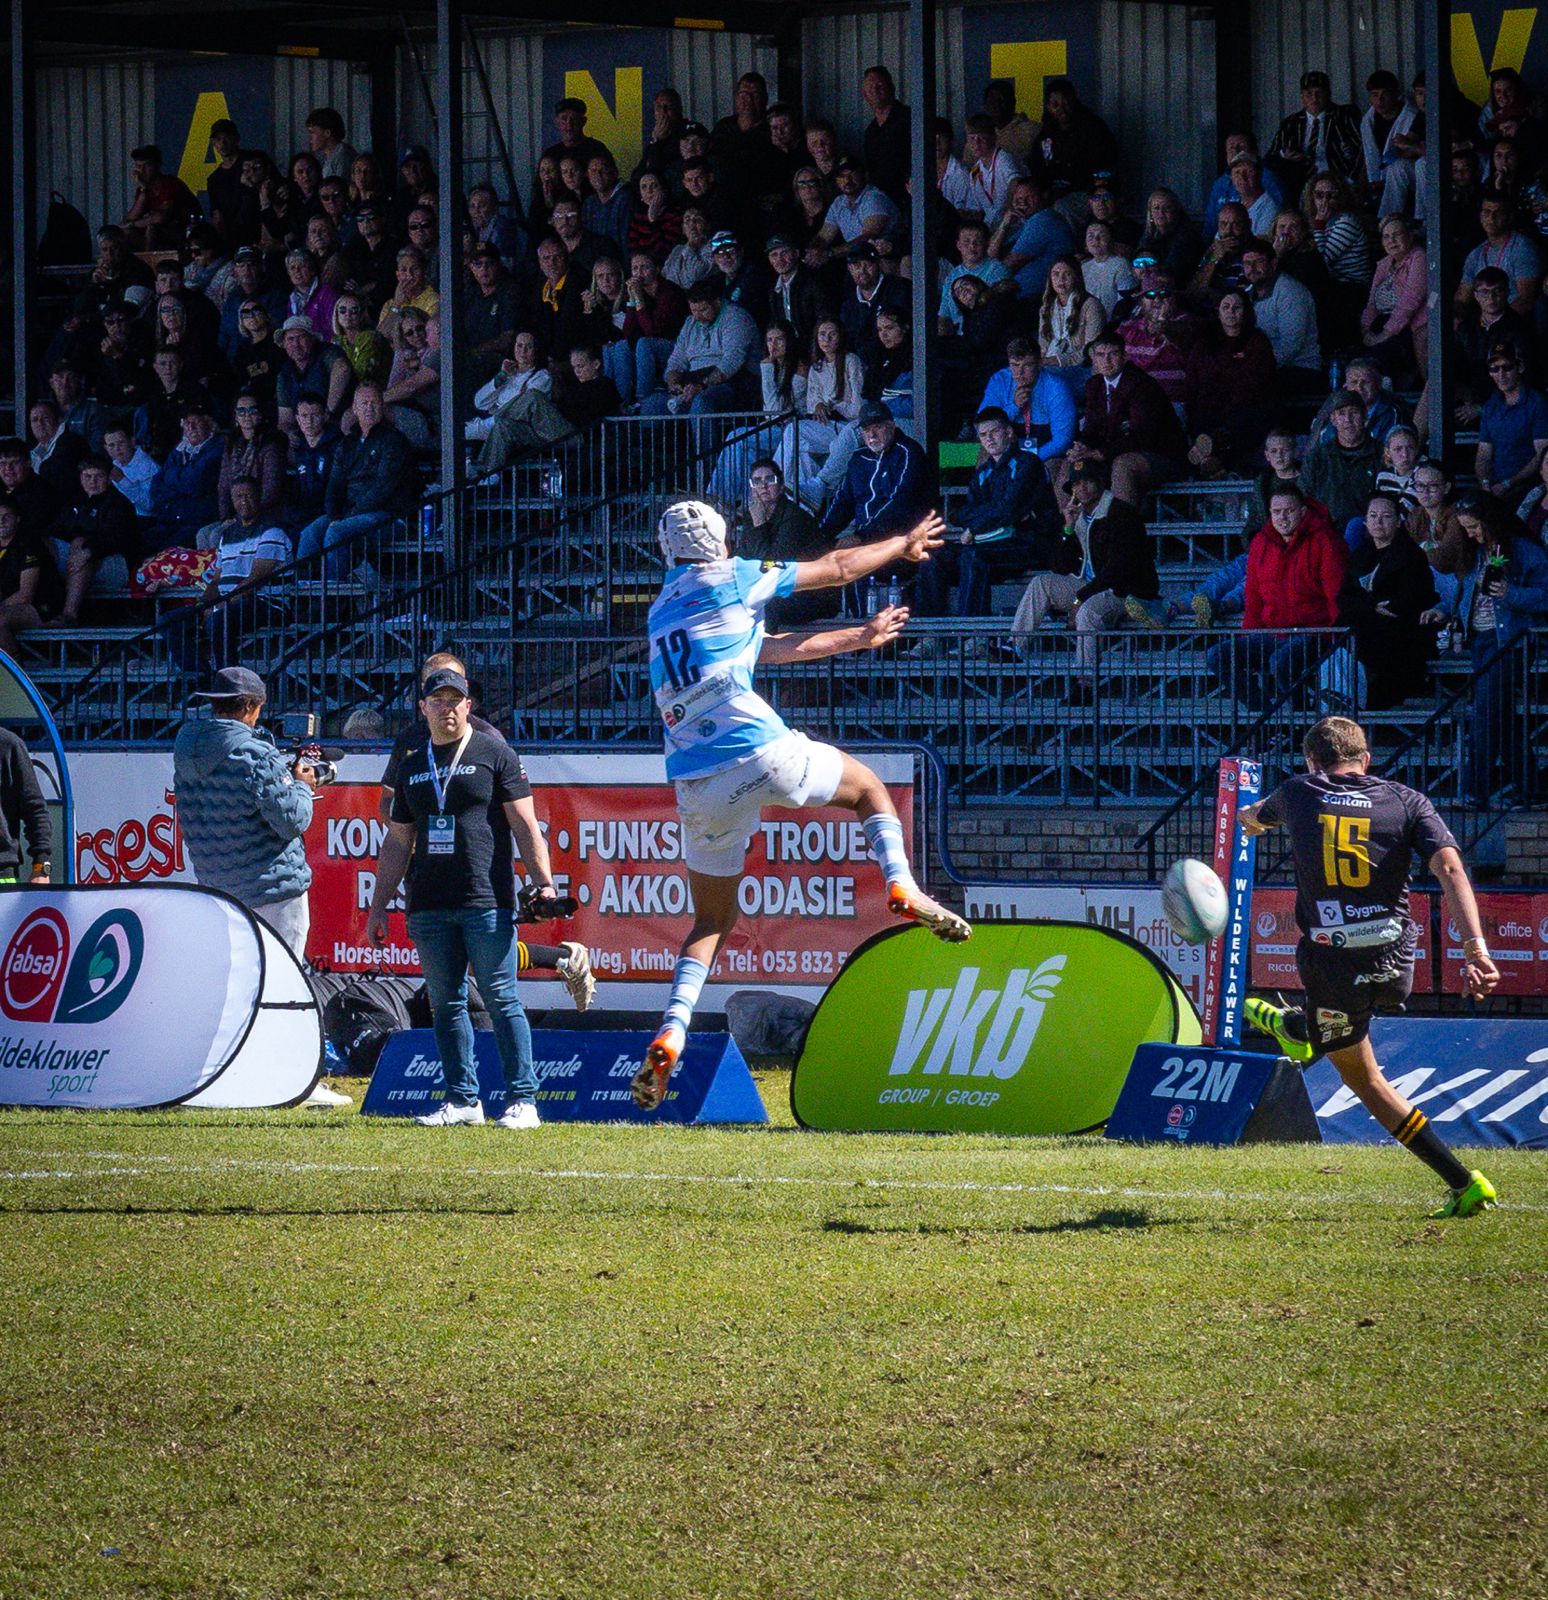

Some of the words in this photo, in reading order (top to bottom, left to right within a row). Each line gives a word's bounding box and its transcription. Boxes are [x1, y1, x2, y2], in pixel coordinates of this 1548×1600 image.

[991, 40, 1067, 122] T
[656, 628, 702, 692] 12
[1322, 793, 1373, 809] santam
[579, 821, 687, 859] FUNKS
[761, 822, 879, 861] TROUE
[1217, 803, 1229, 860] ABSA
[1318, 813, 1372, 888] 15
[599, 875, 855, 916] AKKOODASIE
[1137, 918, 1196, 947] offic
[1498, 922, 1533, 938] office
[12, 944, 54, 975] absa
[334, 942, 420, 966] Horseshoe
[727, 951, 757, 973] Tel:
[763, 951, 797, 973] 053
[801, 951, 834, 974] 832
[1224, 878, 1248, 1038] WILDEKLAWER
[888, 966, 1046, 1080] vkb
[46, 1072, 98, 1099] sport
[878, 1088, 931, 1104] GROUP
[945, 1089, 1001, 1107] GROEP
[1151, 1057, 1243, 1103] 22M
